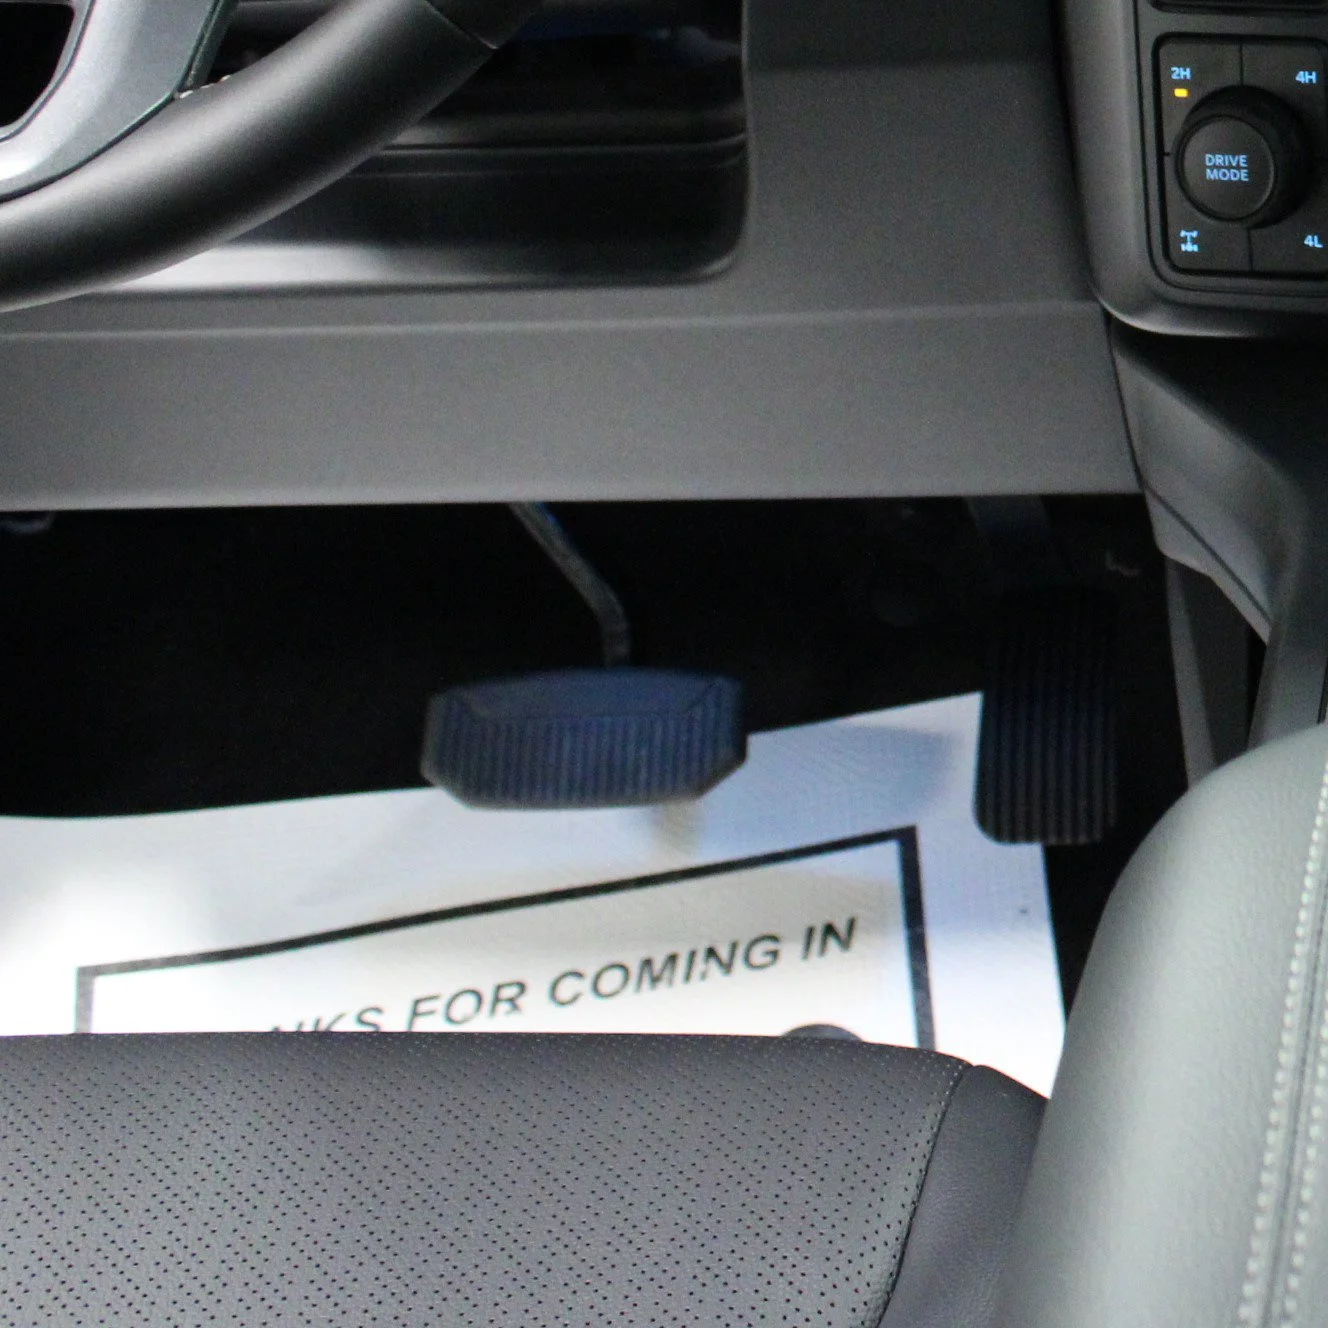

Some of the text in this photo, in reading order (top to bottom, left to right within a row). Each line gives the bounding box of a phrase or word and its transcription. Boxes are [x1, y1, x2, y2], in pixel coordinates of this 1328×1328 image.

[1171, 66, 1191, 80] 2H
[1296, 71, 1317, 84] 4H
[1205, 154, 1248, 168] DRIVE
[1206, 168, 1249, 182] MODE
[1304, 234, 1324, 249] 4L
[407, 980, 526, 1032] FOR
[548, 933, 782, 1006] COMING
[800, 917, 857, 961] IN
